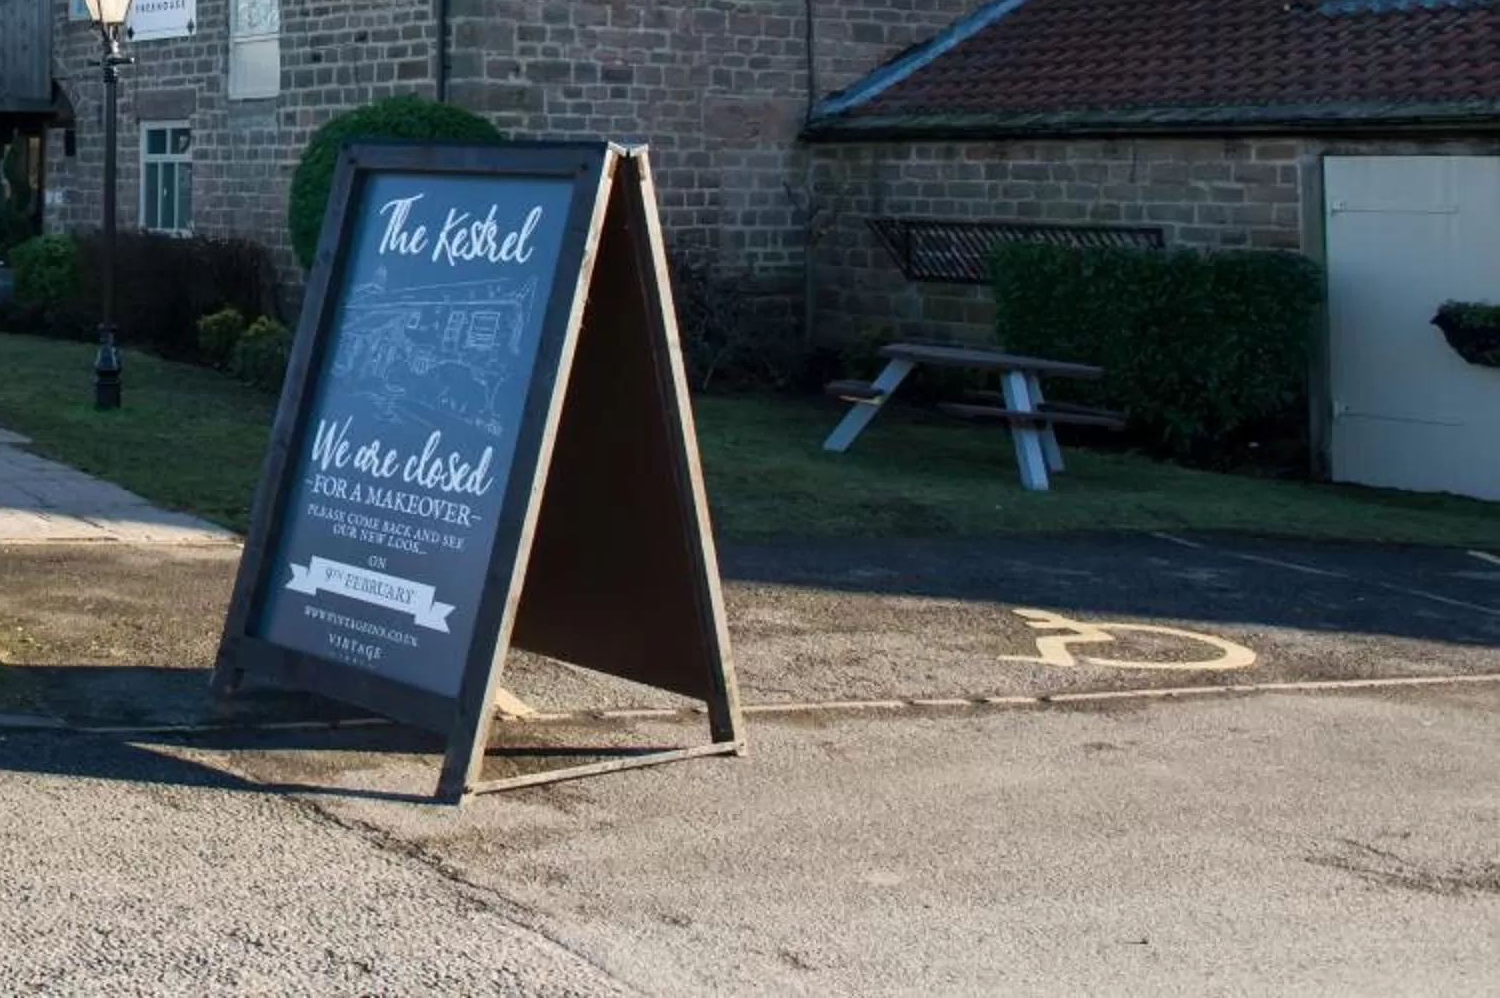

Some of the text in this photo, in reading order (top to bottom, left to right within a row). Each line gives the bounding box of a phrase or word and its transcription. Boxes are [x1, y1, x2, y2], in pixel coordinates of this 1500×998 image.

[379, 193, 543, 266] The Kestrel
[311, 415, 494, 496] We are closed
[350, 482, 361, 503] A
[307, 503, 465, 550] PLEASE COME BACK AND SEE
[333, 522, 357, 539] OUR
[359, 529, 386, 544] NEW
[368, 555, 387, 570] ON
[344, 572, 413, 604] FEBRUARY
[328, 633, 382, 659] VINTAGE
